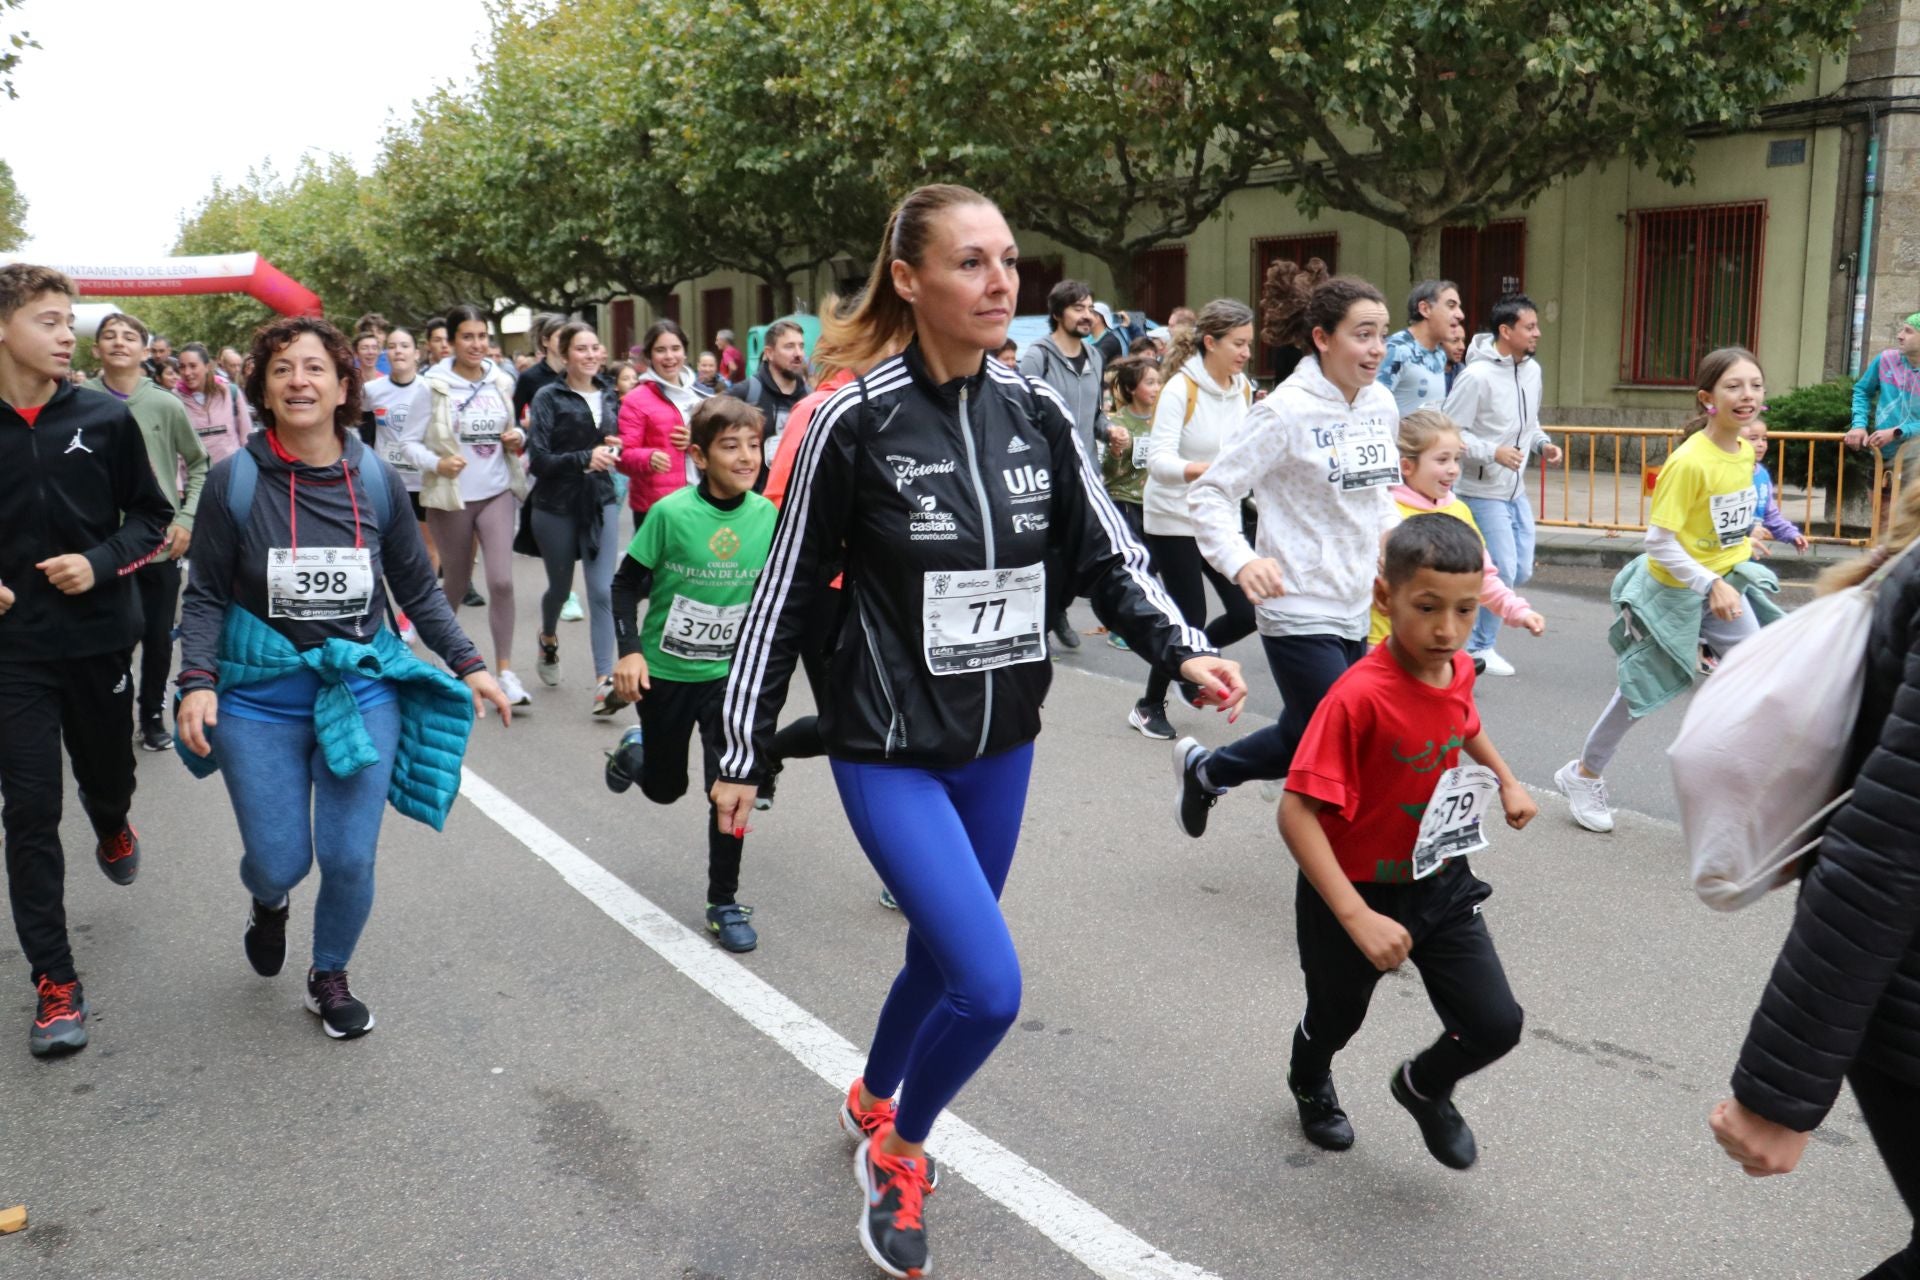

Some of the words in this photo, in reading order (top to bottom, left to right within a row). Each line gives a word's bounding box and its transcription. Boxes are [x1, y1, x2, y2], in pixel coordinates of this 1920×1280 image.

[148, 265, 165, 276] DE
[472, 419, 495, 431] 600
[388, 450, 401, 461] 60
[1356, 444, 1386, 466] 397
[1002, 464, 1050, 495] Ule
[910, 520, 956, 531] castaño
[664, 561, 685, 573] SAN
[686, 567, 717, 578] JUAN
[719, 569, 732, 578] DE
[735, 569, 747, 578] LA
[707, 561, 738, 569] COLEGIO
[295, 571, 347, 594] 398
[968, 598, 1007, 634] 77
[679, 618, 734, 640] 3706
